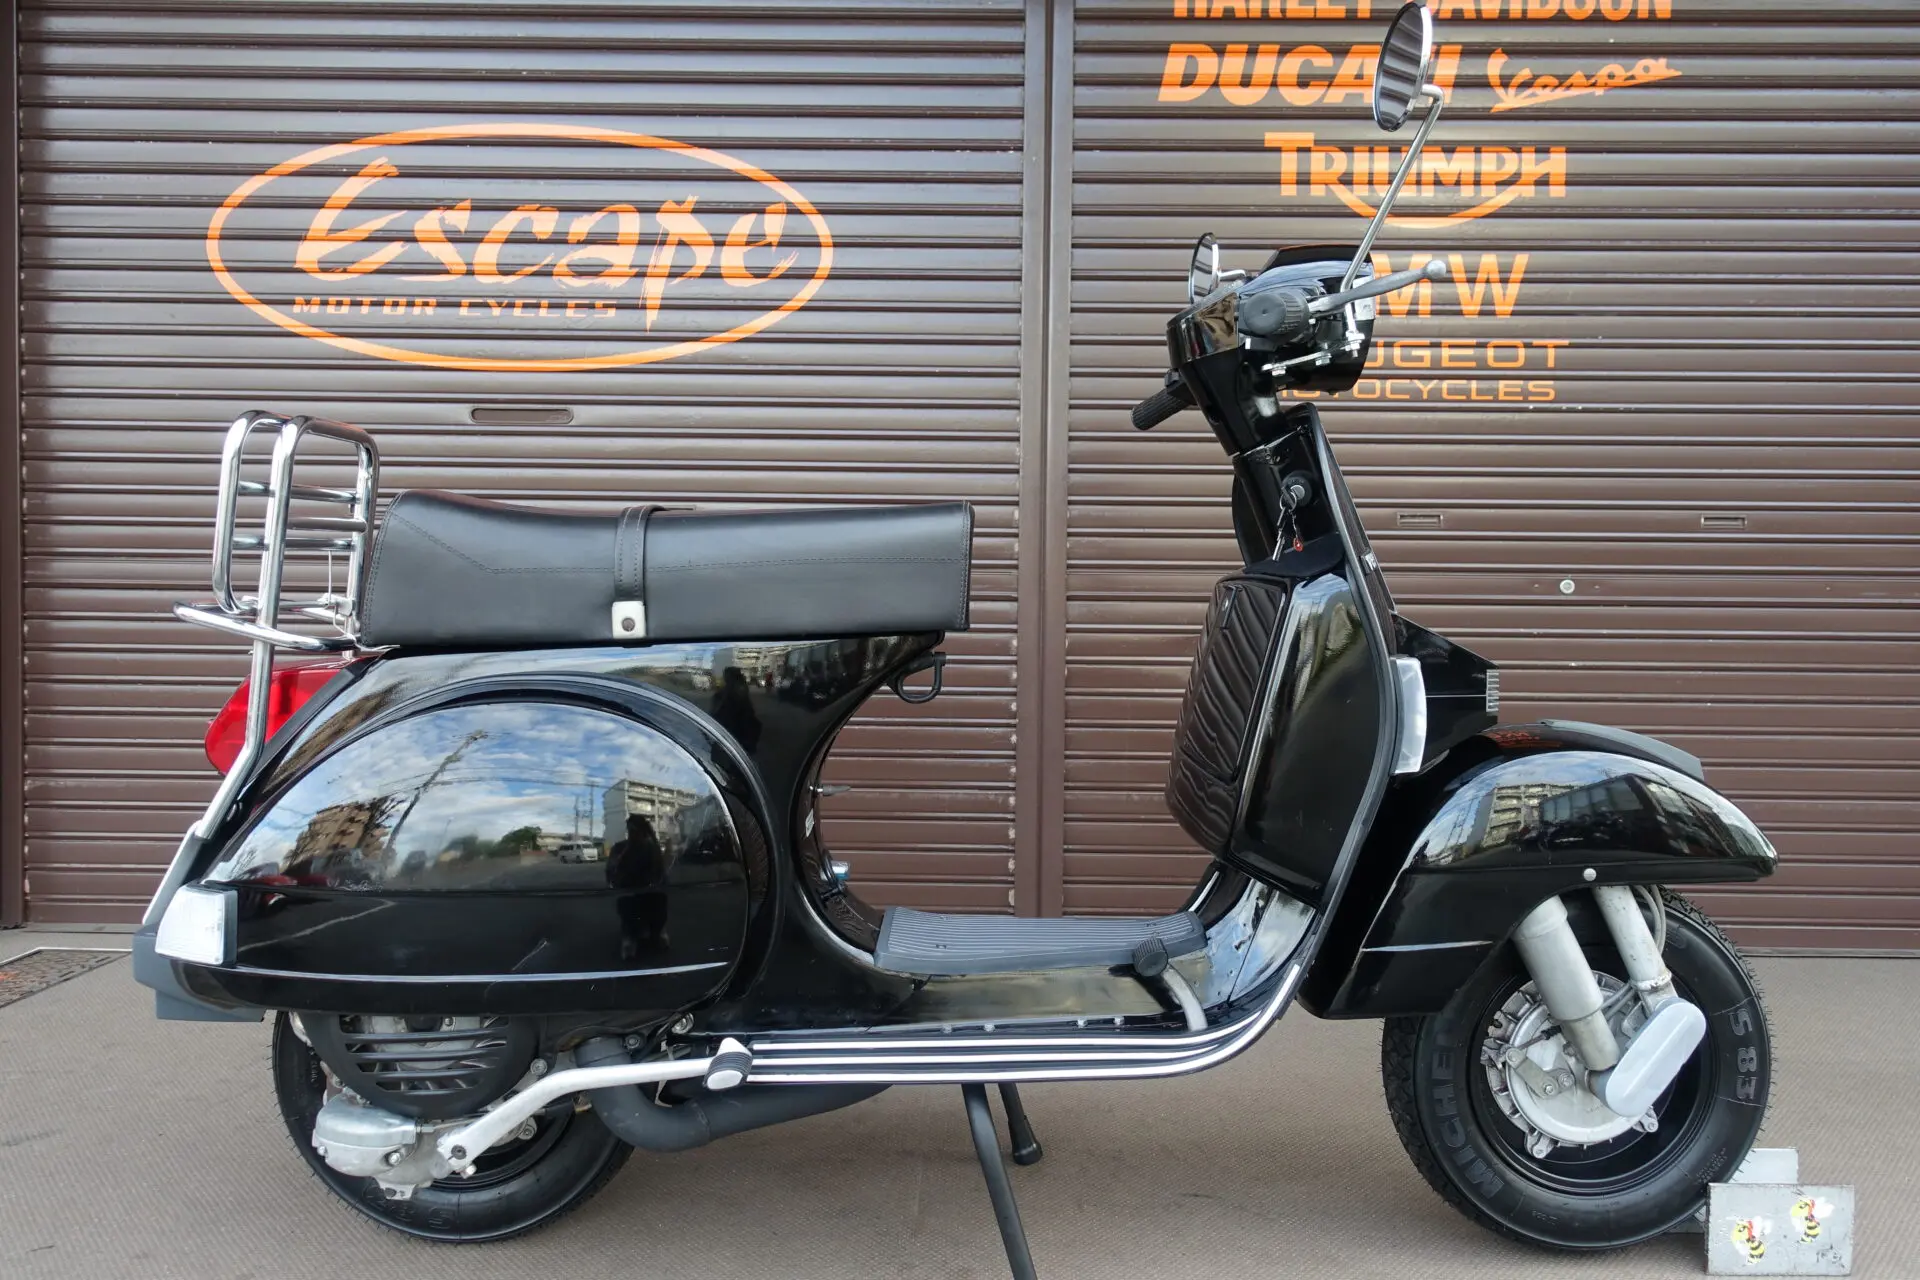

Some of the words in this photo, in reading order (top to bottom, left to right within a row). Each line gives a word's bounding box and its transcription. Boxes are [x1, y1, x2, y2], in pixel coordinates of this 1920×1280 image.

[1157, 44, 1462, 106] DUCAI
[1487, 47, 1682, 113] Vespa
[295, 156, 798, 333] Escape
[293, 296, 437, 315] MOTOR
[459, 298, 618, 318] CYCLES
[1371, 254, 1529, 319] MW
